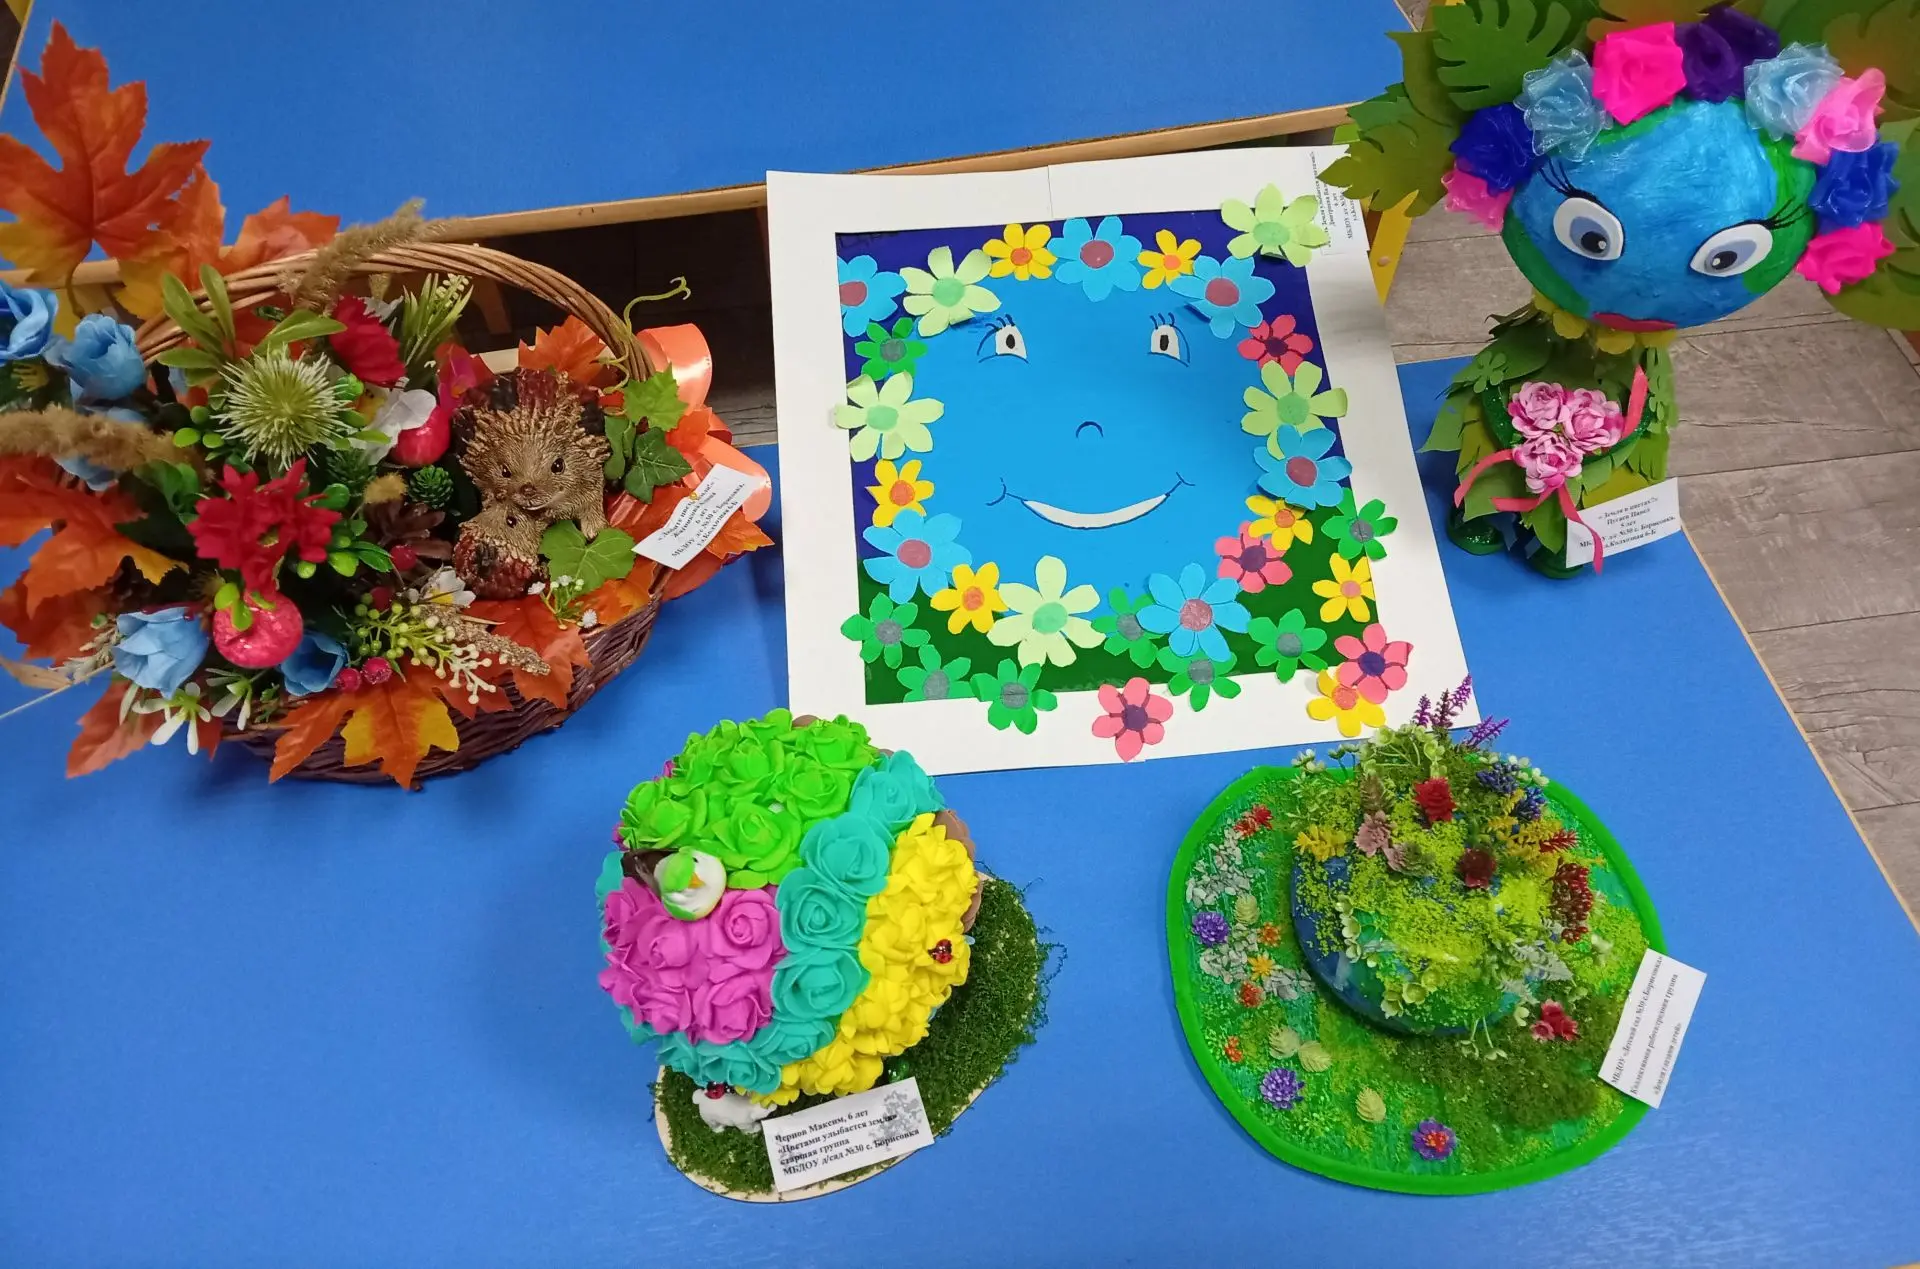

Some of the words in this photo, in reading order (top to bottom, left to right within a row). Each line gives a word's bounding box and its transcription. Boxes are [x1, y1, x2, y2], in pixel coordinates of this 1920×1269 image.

[808, 1115, 847, 1133] Максим,
[846, 1112, 853, 1121] 6
[853, 1108, 868, 1119] лет
[779, 1148, 818, 1167] старшая
[818, 1138, 850, 1154] группа
[782, 1159, 819, 1178] МБДОУ
[843, 1144, 864, 1158] №30
[865, 1143, 873, 1151] с.
[873, 1128, 920, 1148] Борисовка
